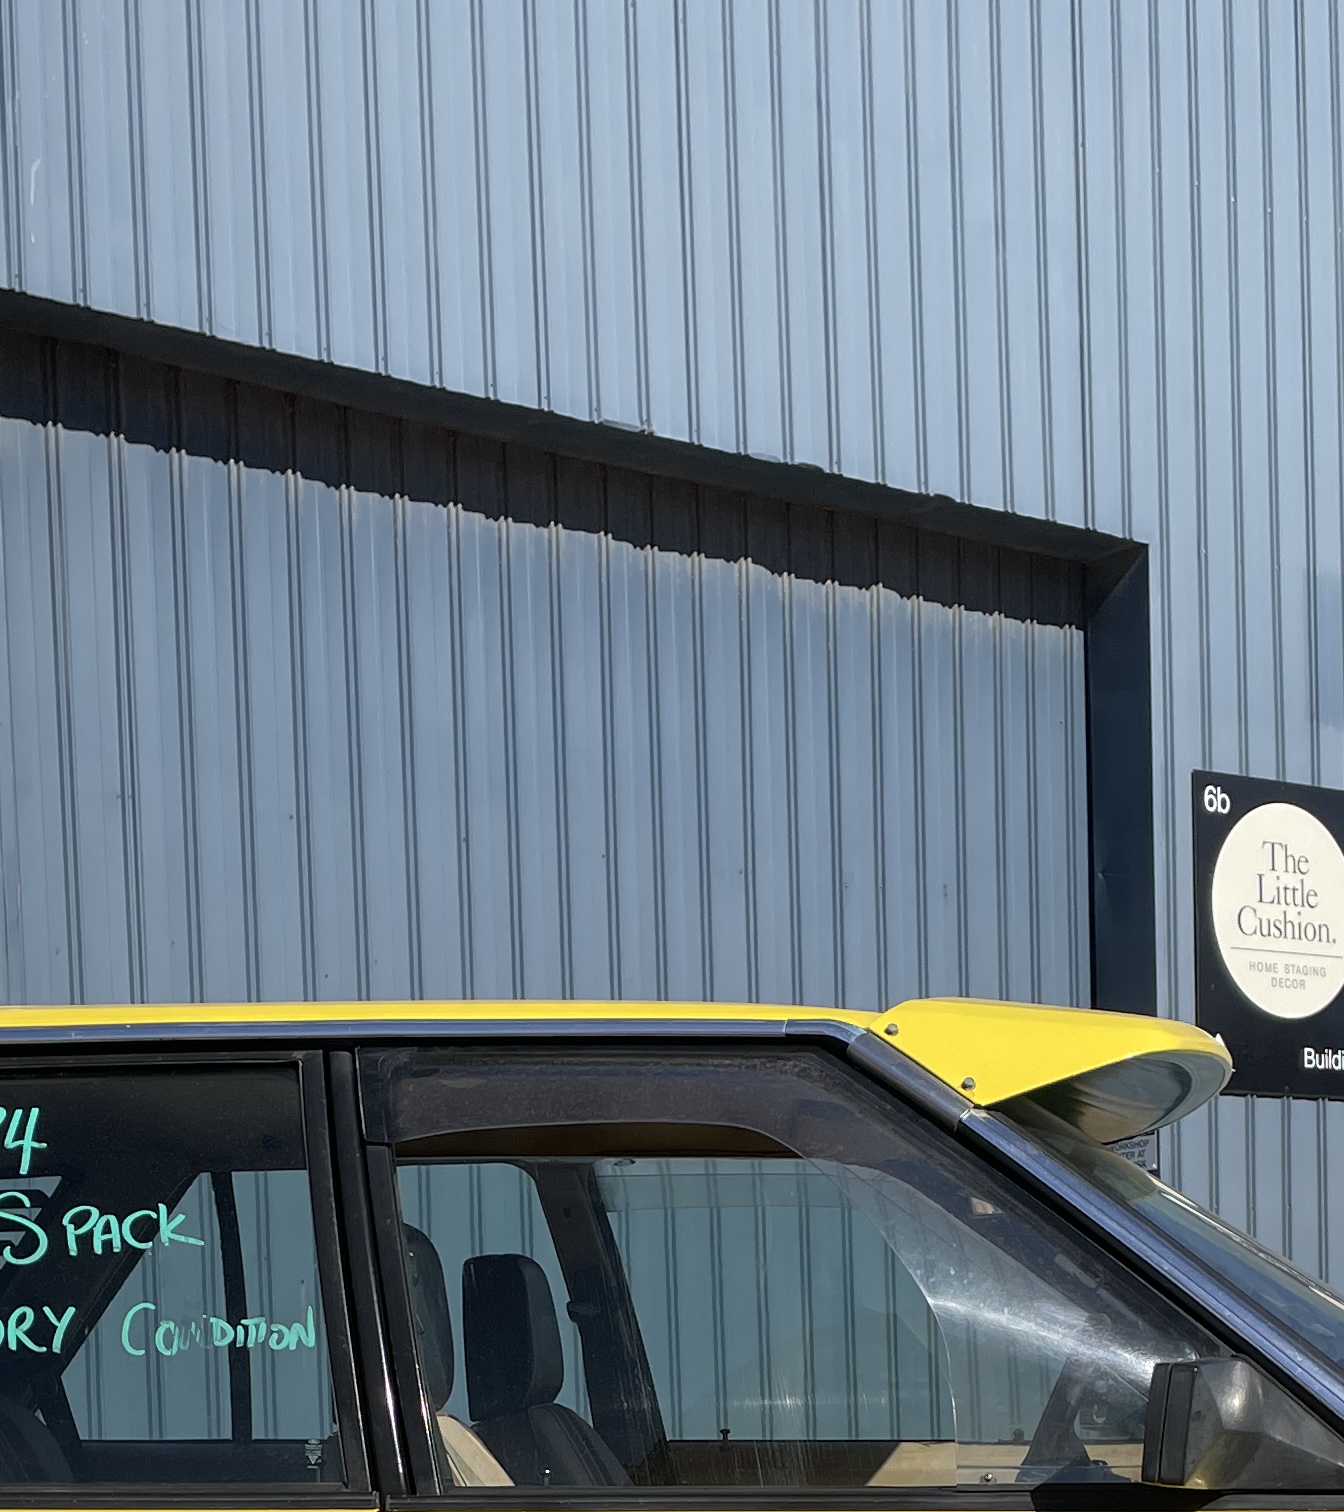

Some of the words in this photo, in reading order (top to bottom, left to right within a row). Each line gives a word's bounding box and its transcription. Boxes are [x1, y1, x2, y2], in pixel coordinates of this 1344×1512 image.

[1203, 784, 1231, 814] 6b
[1262, 840, 1310, 876] The
[1256, 873, 1319, 909] Little
[1237, 905, 1337, 945] Cushion.
[1249, 960, 1279, 974] HOME
[1283, 962, 1327, 978] STAGING
[1270, 977, 1306, 990] DECOR
[1112, 1139, 1149, 1151] ORKSHOP
[62, 1202, 205, 1257] PACK
[121, 1302, 316, 1356] CODITION
